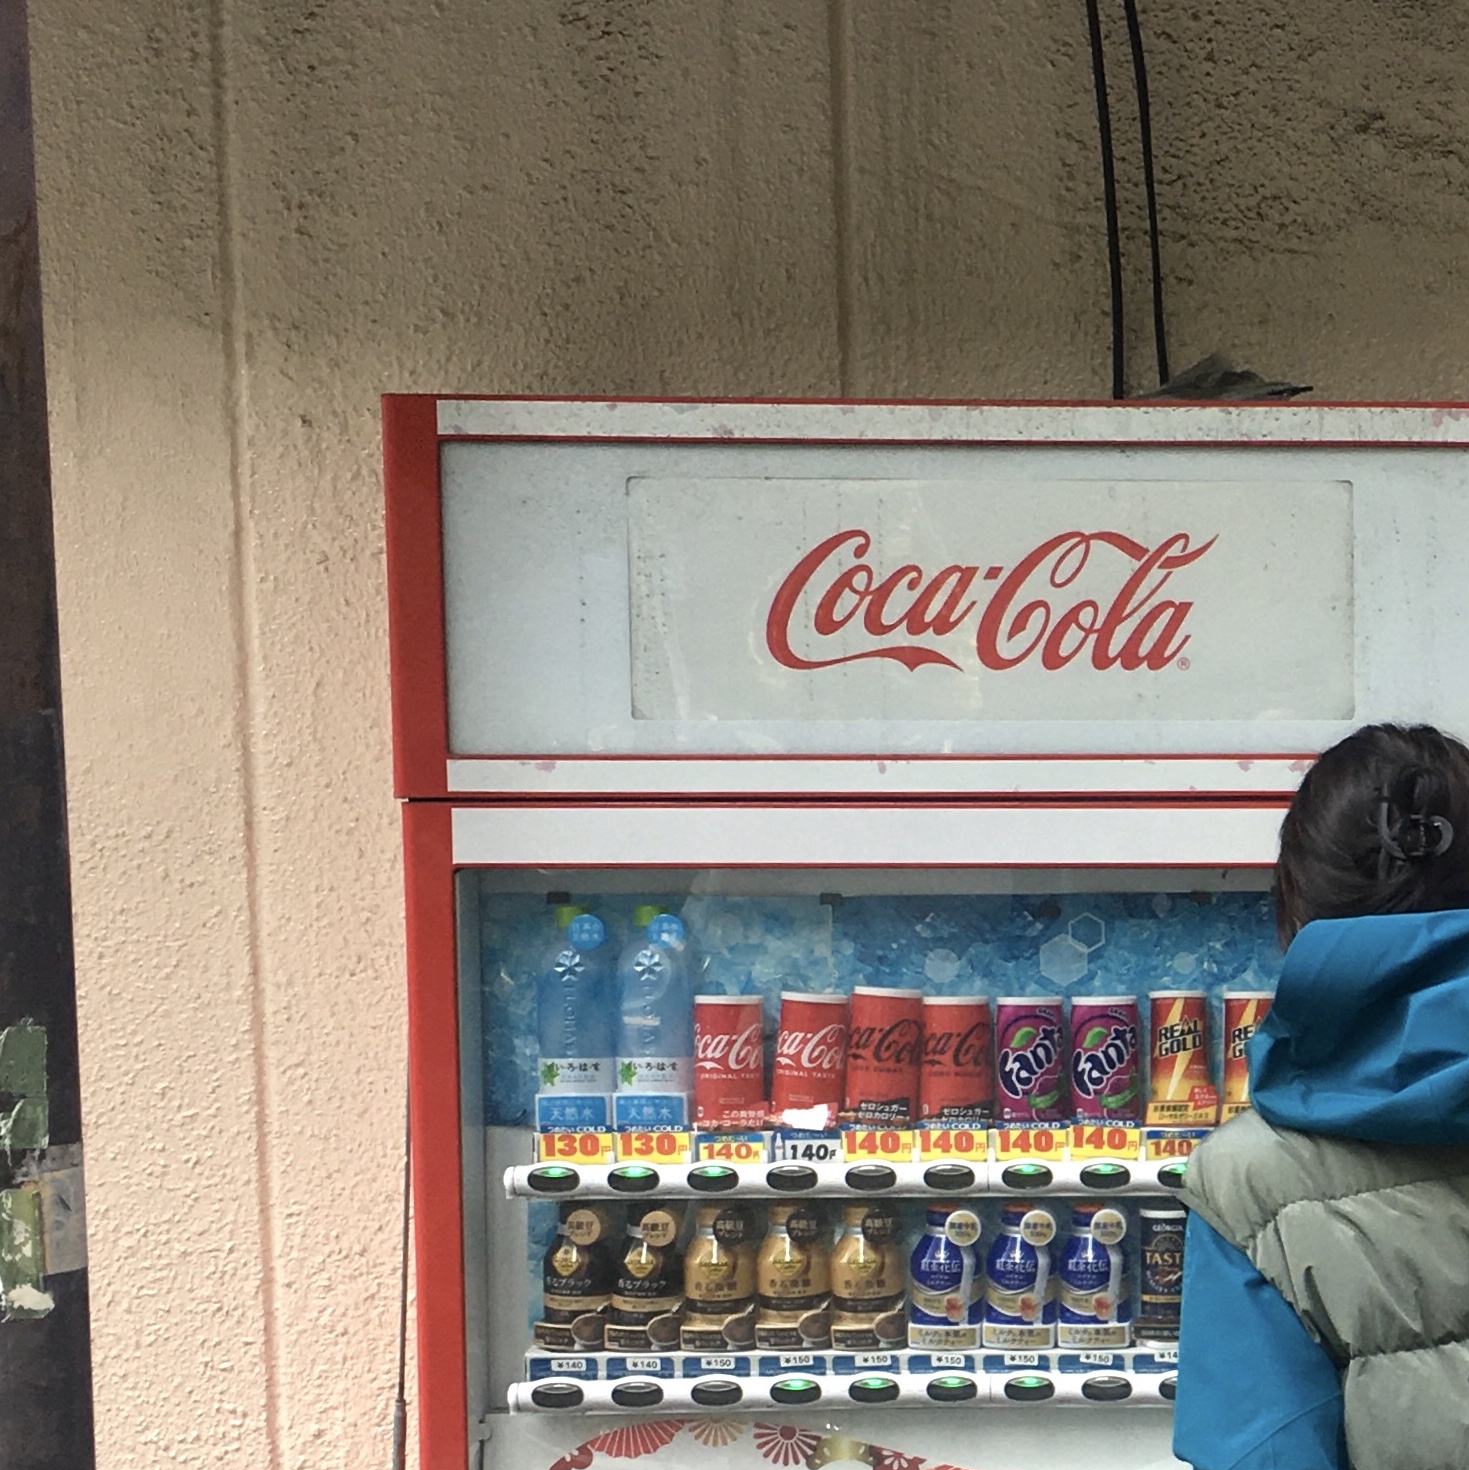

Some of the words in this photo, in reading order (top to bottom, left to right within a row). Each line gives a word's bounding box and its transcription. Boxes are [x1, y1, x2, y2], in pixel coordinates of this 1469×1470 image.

[766, 530, 1219, 672] Coca-Cola
[1159, 1015, 1200, 1043] REAL
[1159, 1034, 1202, 1058] GOLD
[1072, 1026, 1137, 1099] Fanta
[551, 1107, 595, 1120] 天然水
[628, 1107, 672, 1120] 天然水
[860, 1103, 907, 1111] ゼロシュガー
[845, 1131, 911, 1154] 140円
[920, 1131, 985, 1152] 140円
[1073, 1127, 1137, 1150] 140円
[921, 1259, 961, 1272] 紅茶花伝
[996, 1259, 1036, 1272] 紅茶花伝
[1068, 1259, 1108, 1272] 紅茶花伝
[547, 1277, 591, 1286] 香るブラック
[618, 1279, 667, 1289] 香るブラック
[557, 1361, 583, 1369] ¥140
[784, 1356, 810, 1364] ¥150
[863, 1356, 888, 1364] ¥150
[936, 1356, 961, 1364] ¥150
[1085, 1354, 1109, 1363] ¥150
